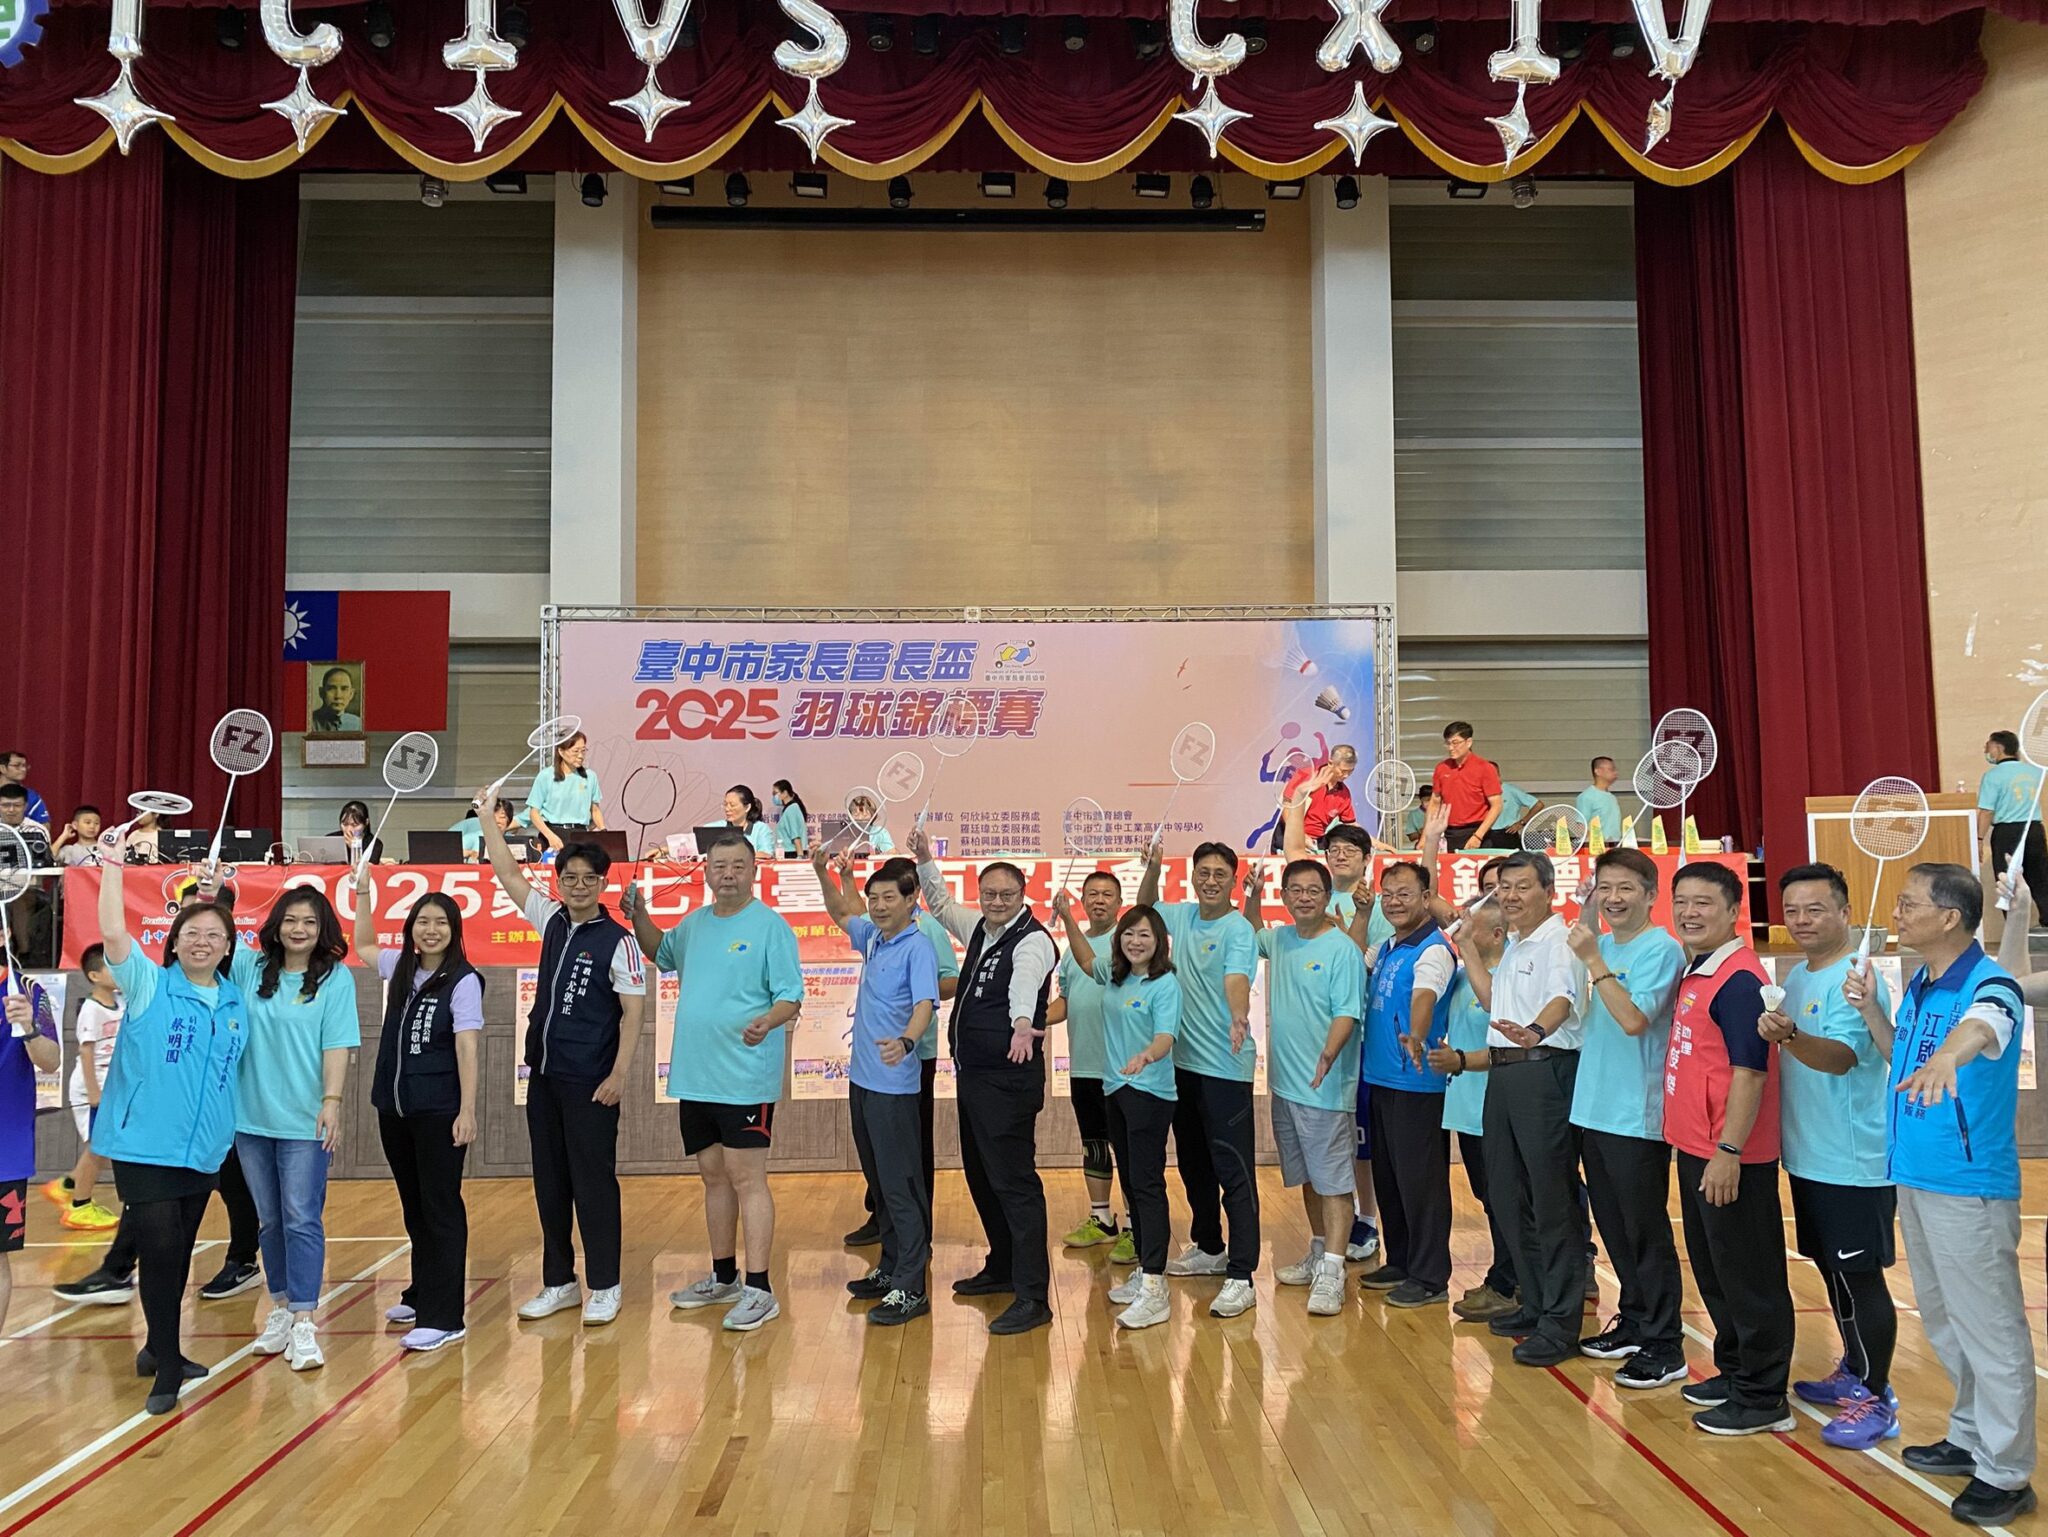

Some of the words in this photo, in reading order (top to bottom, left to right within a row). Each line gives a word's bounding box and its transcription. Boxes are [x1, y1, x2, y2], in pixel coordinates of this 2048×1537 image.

[633, 639, 979, 684] 臺中市家長會長盃
[635, 688, 781, 740] 2025
[790, 687, 1047, 740] 羽球錦標賽
[221, 725, 264, 754] FZ
[1177, 734, 1210, 767] FZ
[886, 761, 919, 790] FZ
[140, 795, 182, 809] FZ
[960, 811, 1040, 821] 何欣純立委服務處
[577, 967, 592, 996] 教育局
